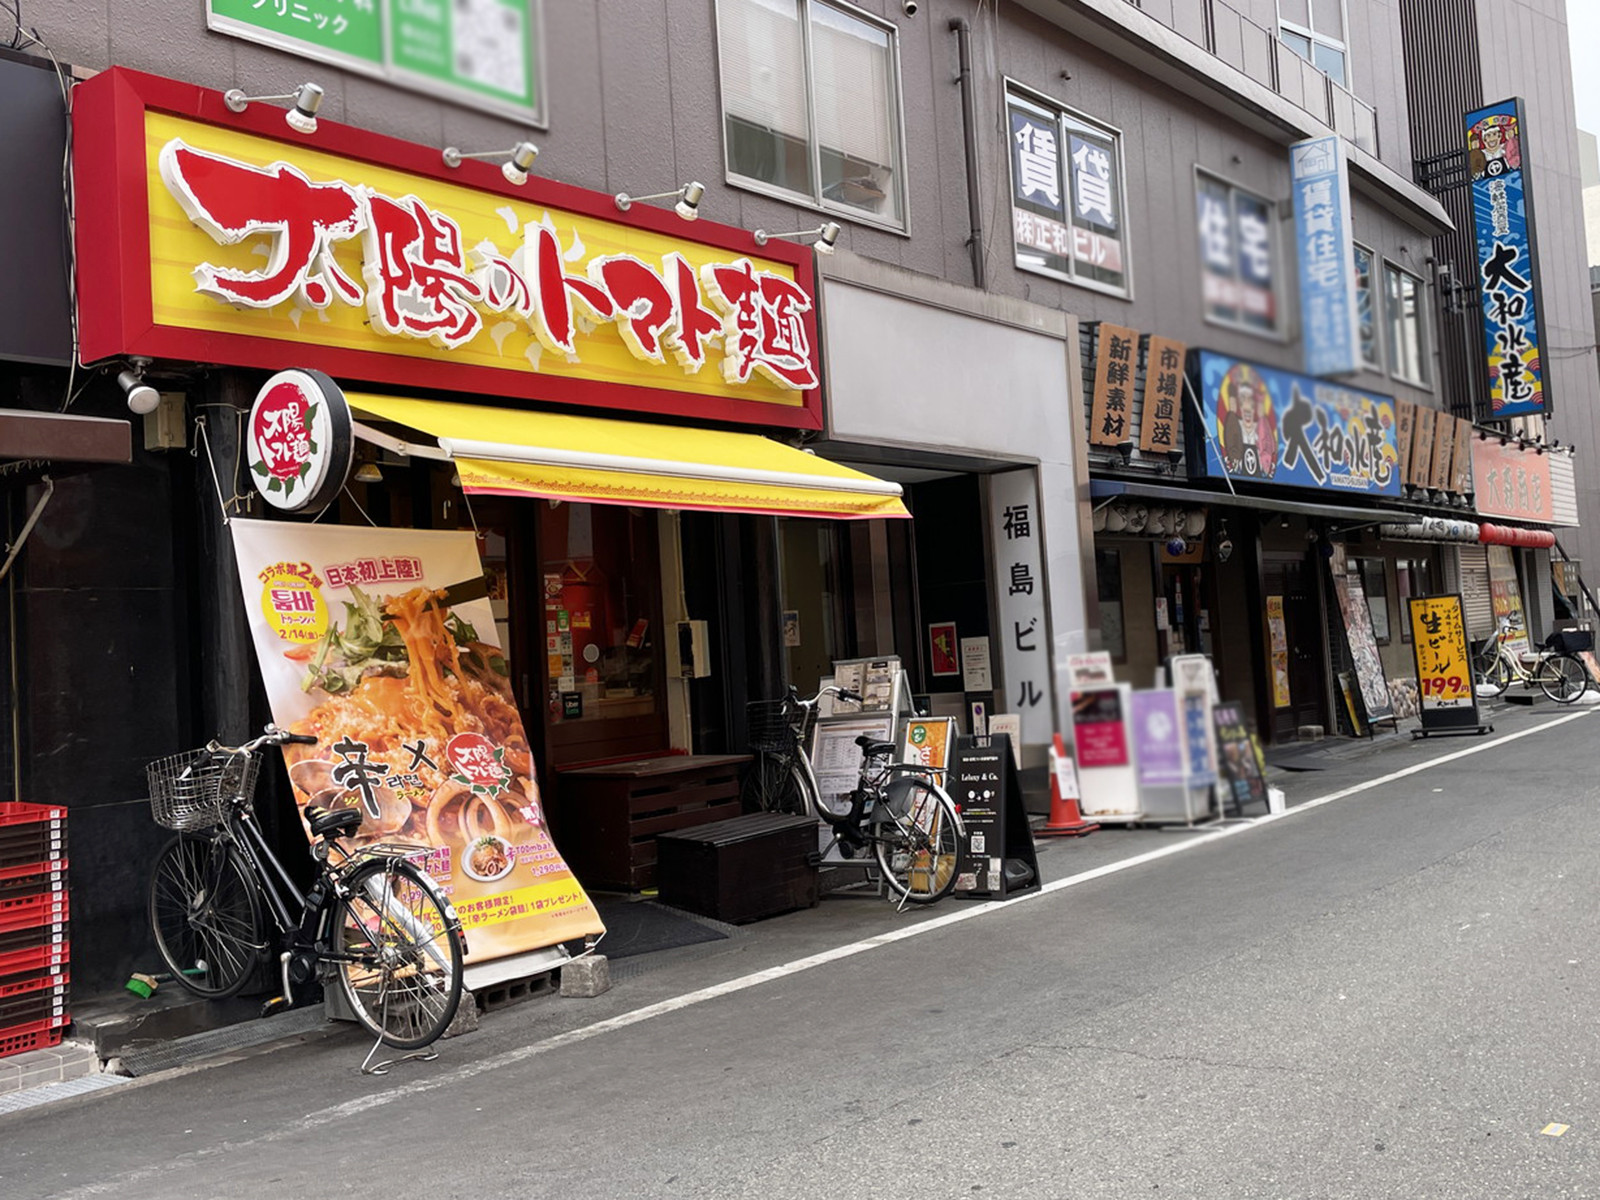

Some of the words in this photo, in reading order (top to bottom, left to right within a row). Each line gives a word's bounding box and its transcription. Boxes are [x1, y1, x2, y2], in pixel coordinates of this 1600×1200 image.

[158, 138, 820, 390] 太陽のトマト麺
[1303, 179, 1339, 287] 賃貸住宅
[1481, 242, 1531, 401] 大和水産
[1102, 333, 1132, 438] 新鮮素材
[1151, 346, 1181, 446] 市場直送
[1282, 378, 1392, 486] 大和水産
[325, 558, 422, 586] 日本初上陸!
[1002, 504, 1043, 708] 福島ビル
[1420, 611, 1451, 674] 生ビール
[332, 737, 389, 819] 辛
